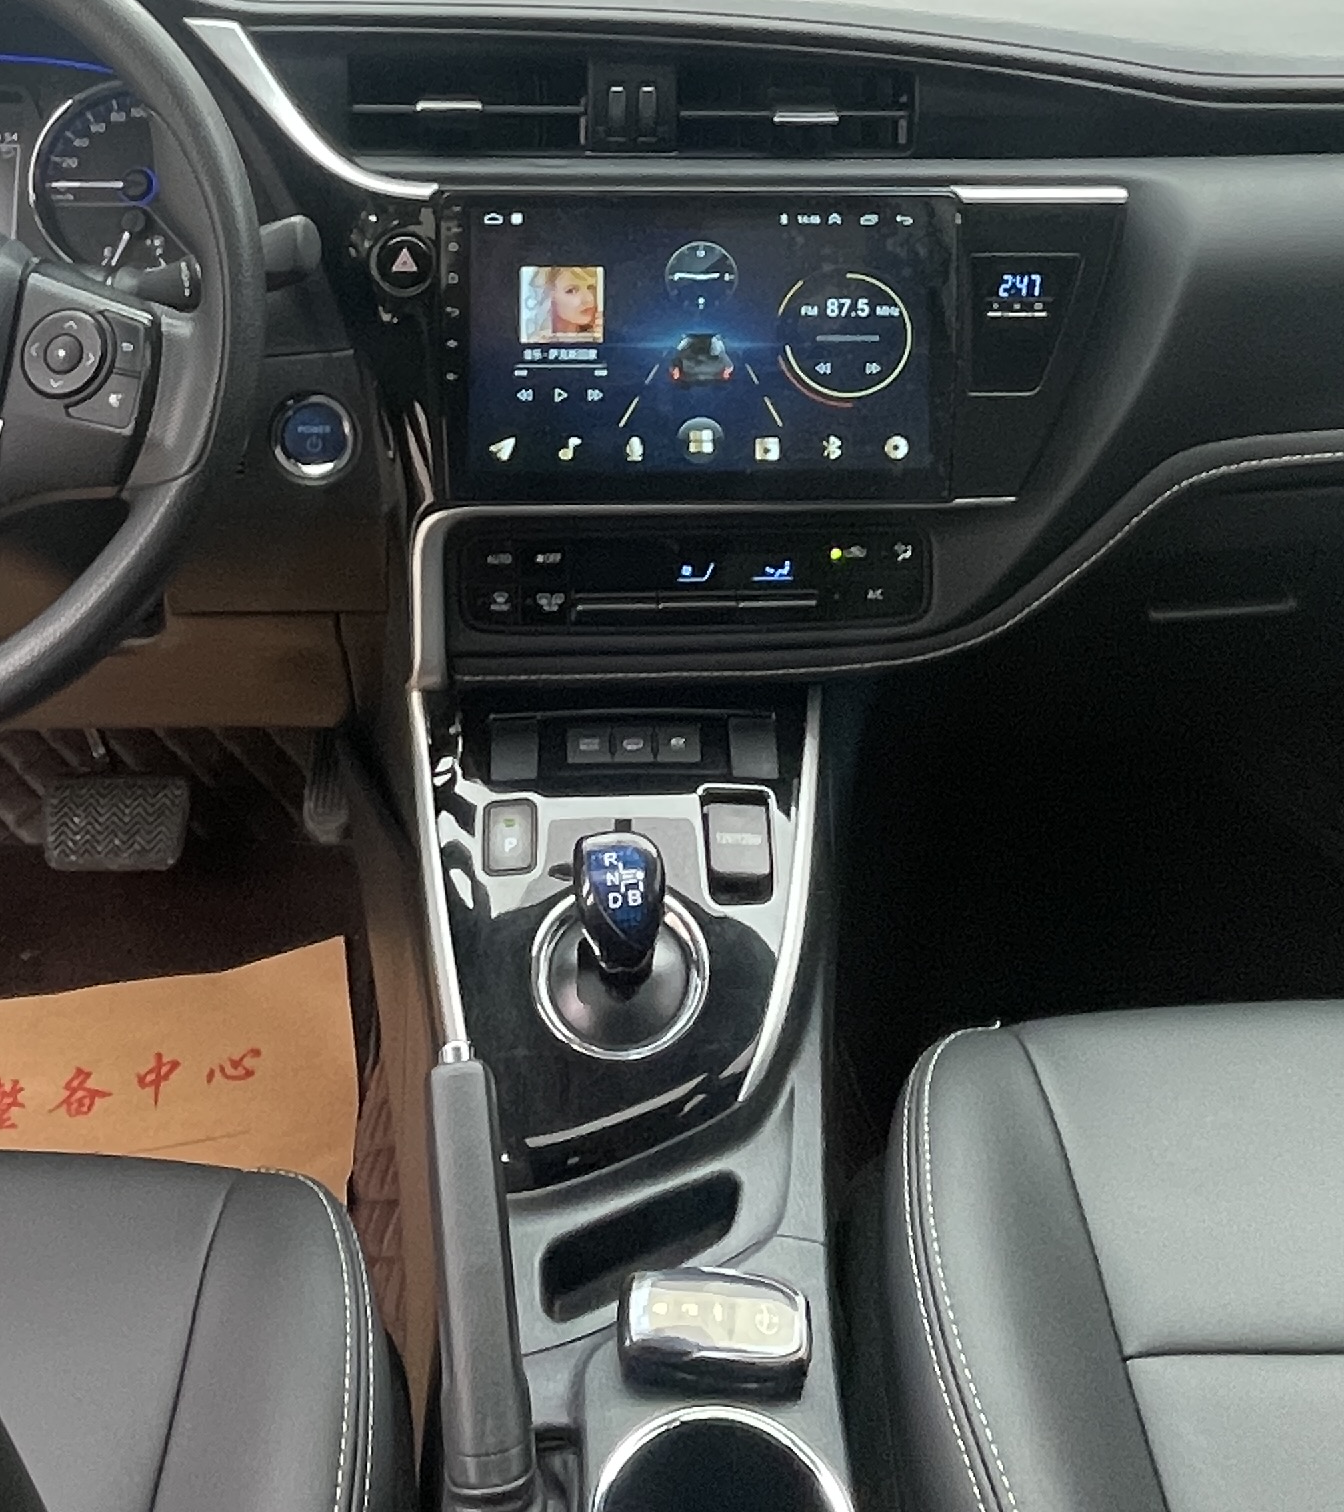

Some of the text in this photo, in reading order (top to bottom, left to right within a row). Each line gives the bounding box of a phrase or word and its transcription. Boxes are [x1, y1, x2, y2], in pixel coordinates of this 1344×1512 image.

[998, 274, 1042, 298] 2:47
[826, 298, 870, 318] 87.5
[504, 837, 518, 852] P
[603, 852, 618, 867] R
[606, 871, 620, 886] N
[608, 889, 642, 908] D B
